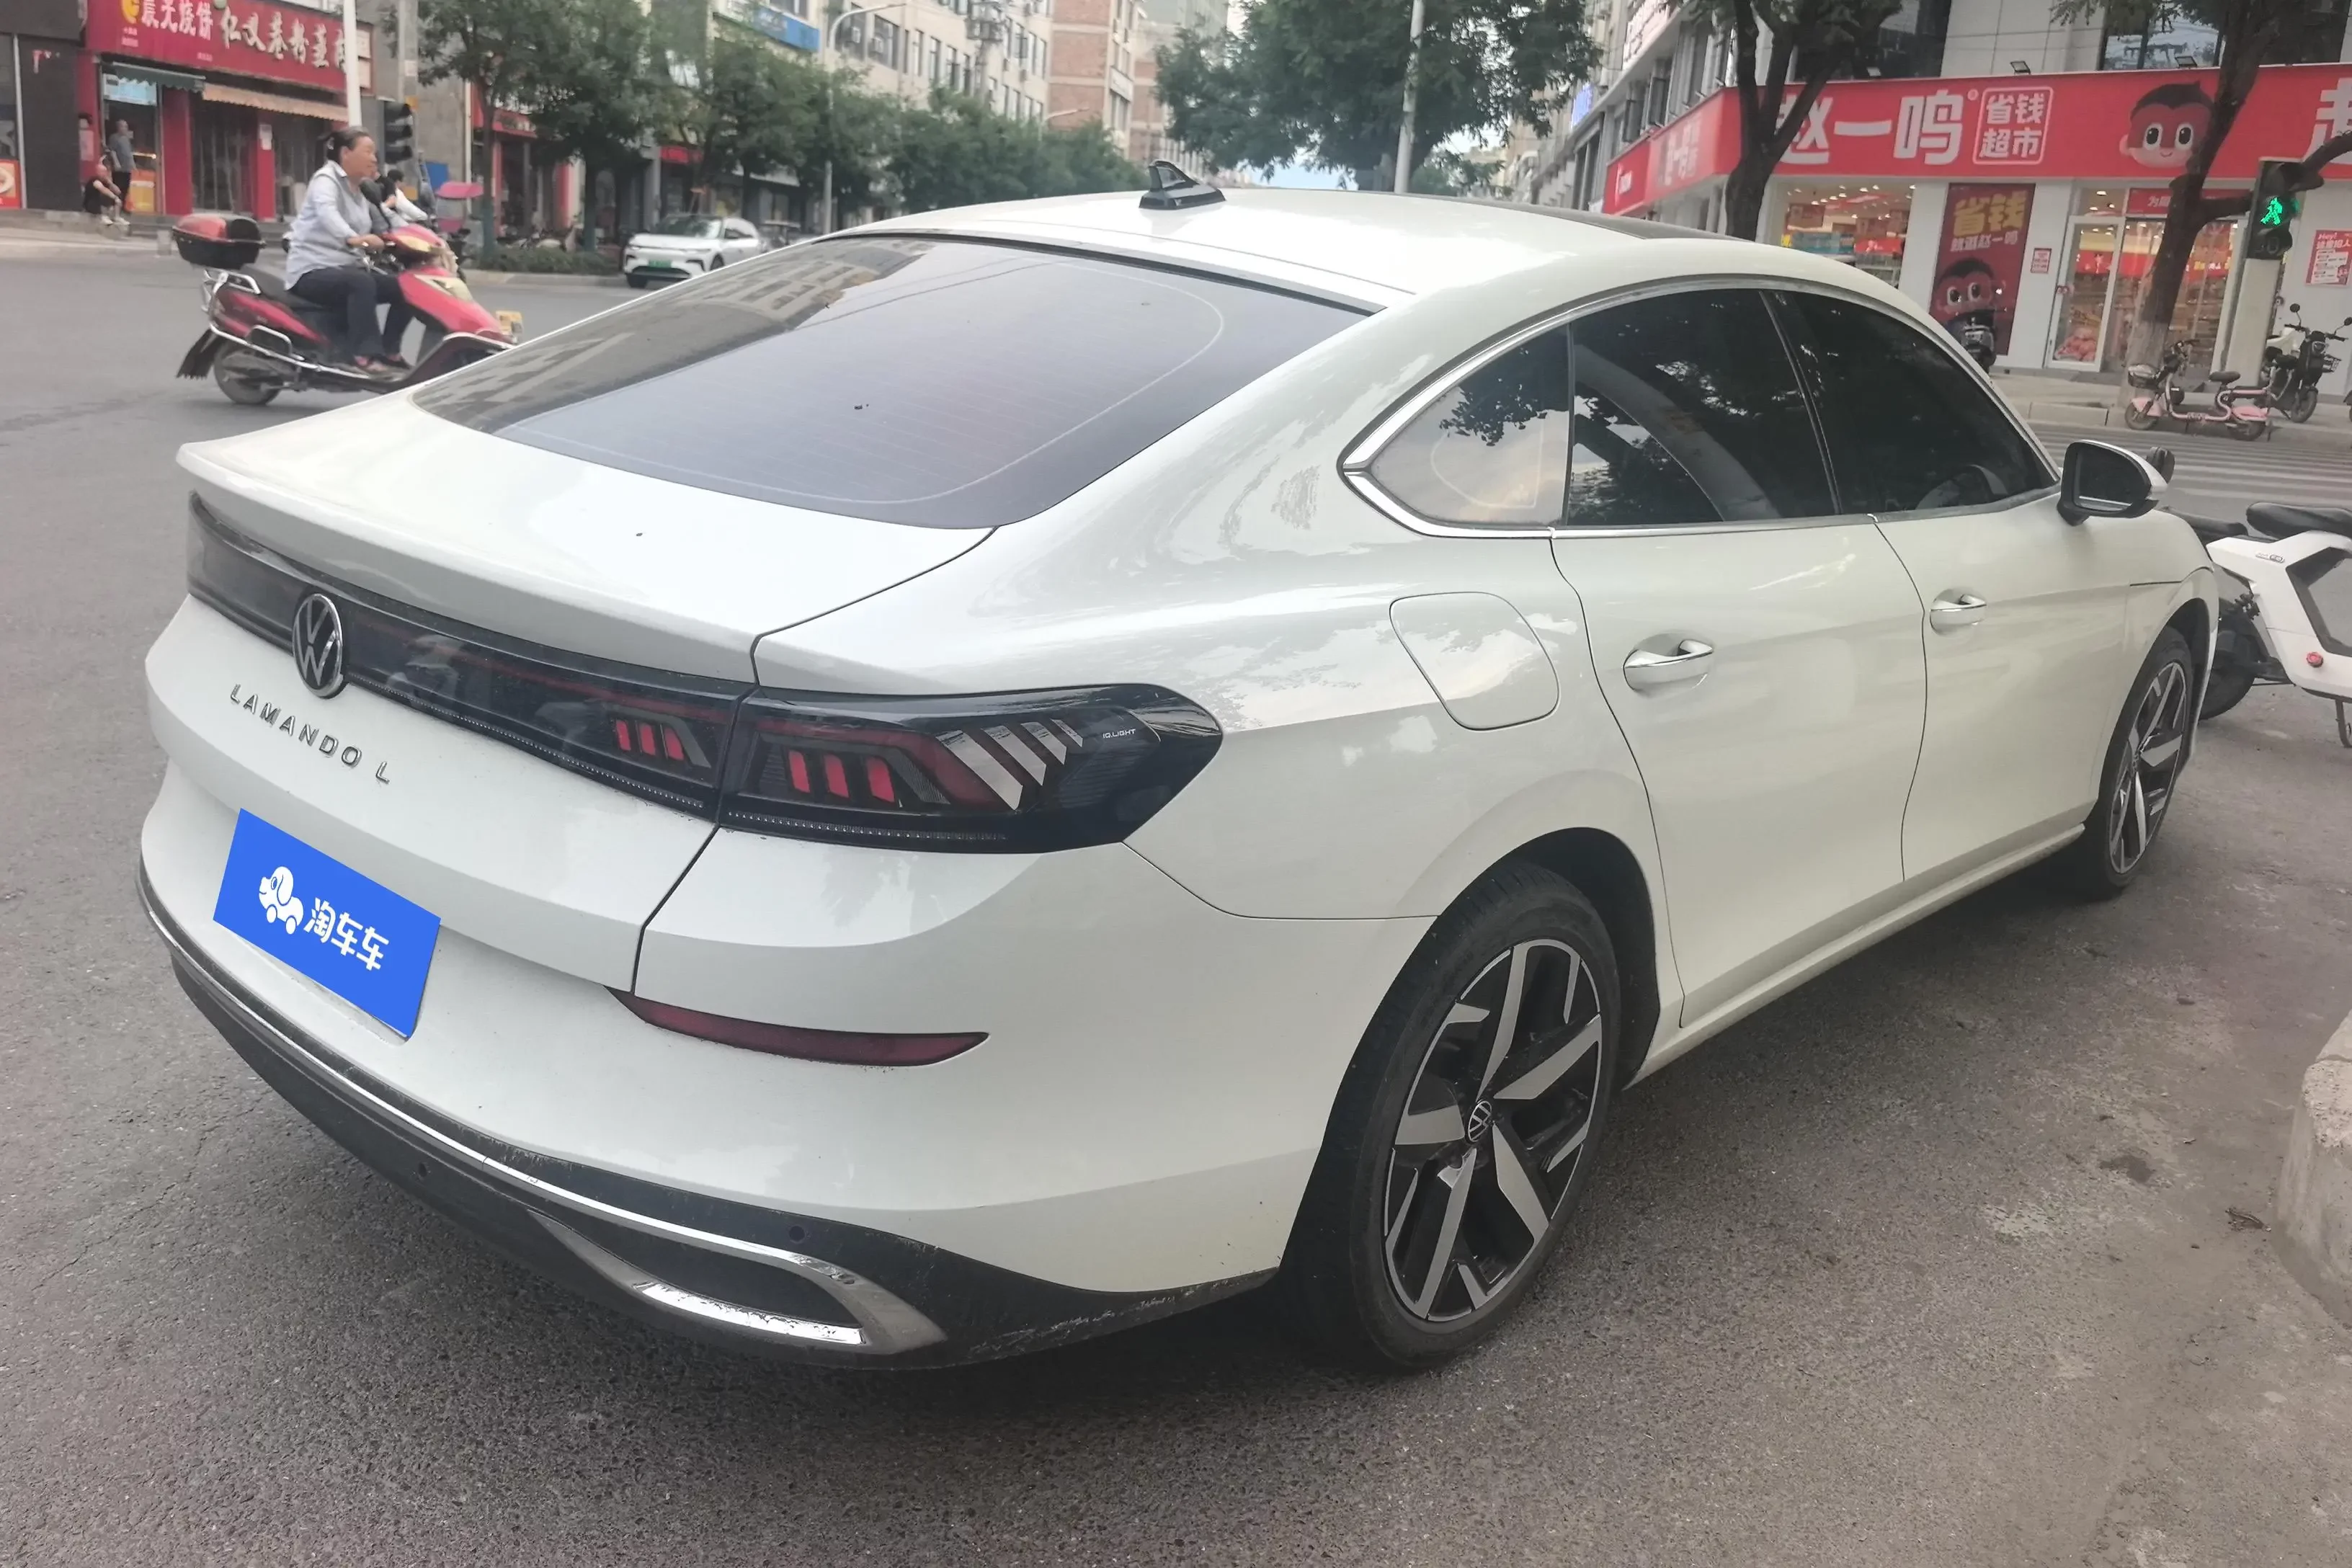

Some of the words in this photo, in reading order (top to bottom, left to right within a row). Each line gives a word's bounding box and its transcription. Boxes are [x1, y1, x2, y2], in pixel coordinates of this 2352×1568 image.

[1776, 89, 1964, 165] 赵一鸣
[1986, 92, 2045, 124] 省钱
[1979, 128, 2042, 159] 超市
[1953, 190, 2028, 237] 省钱
[230, 684, 362, 767] LAMANDO
[375, 761, 390, 784] L
[1102, 729, 1136, 739] IQ.LIGHT
